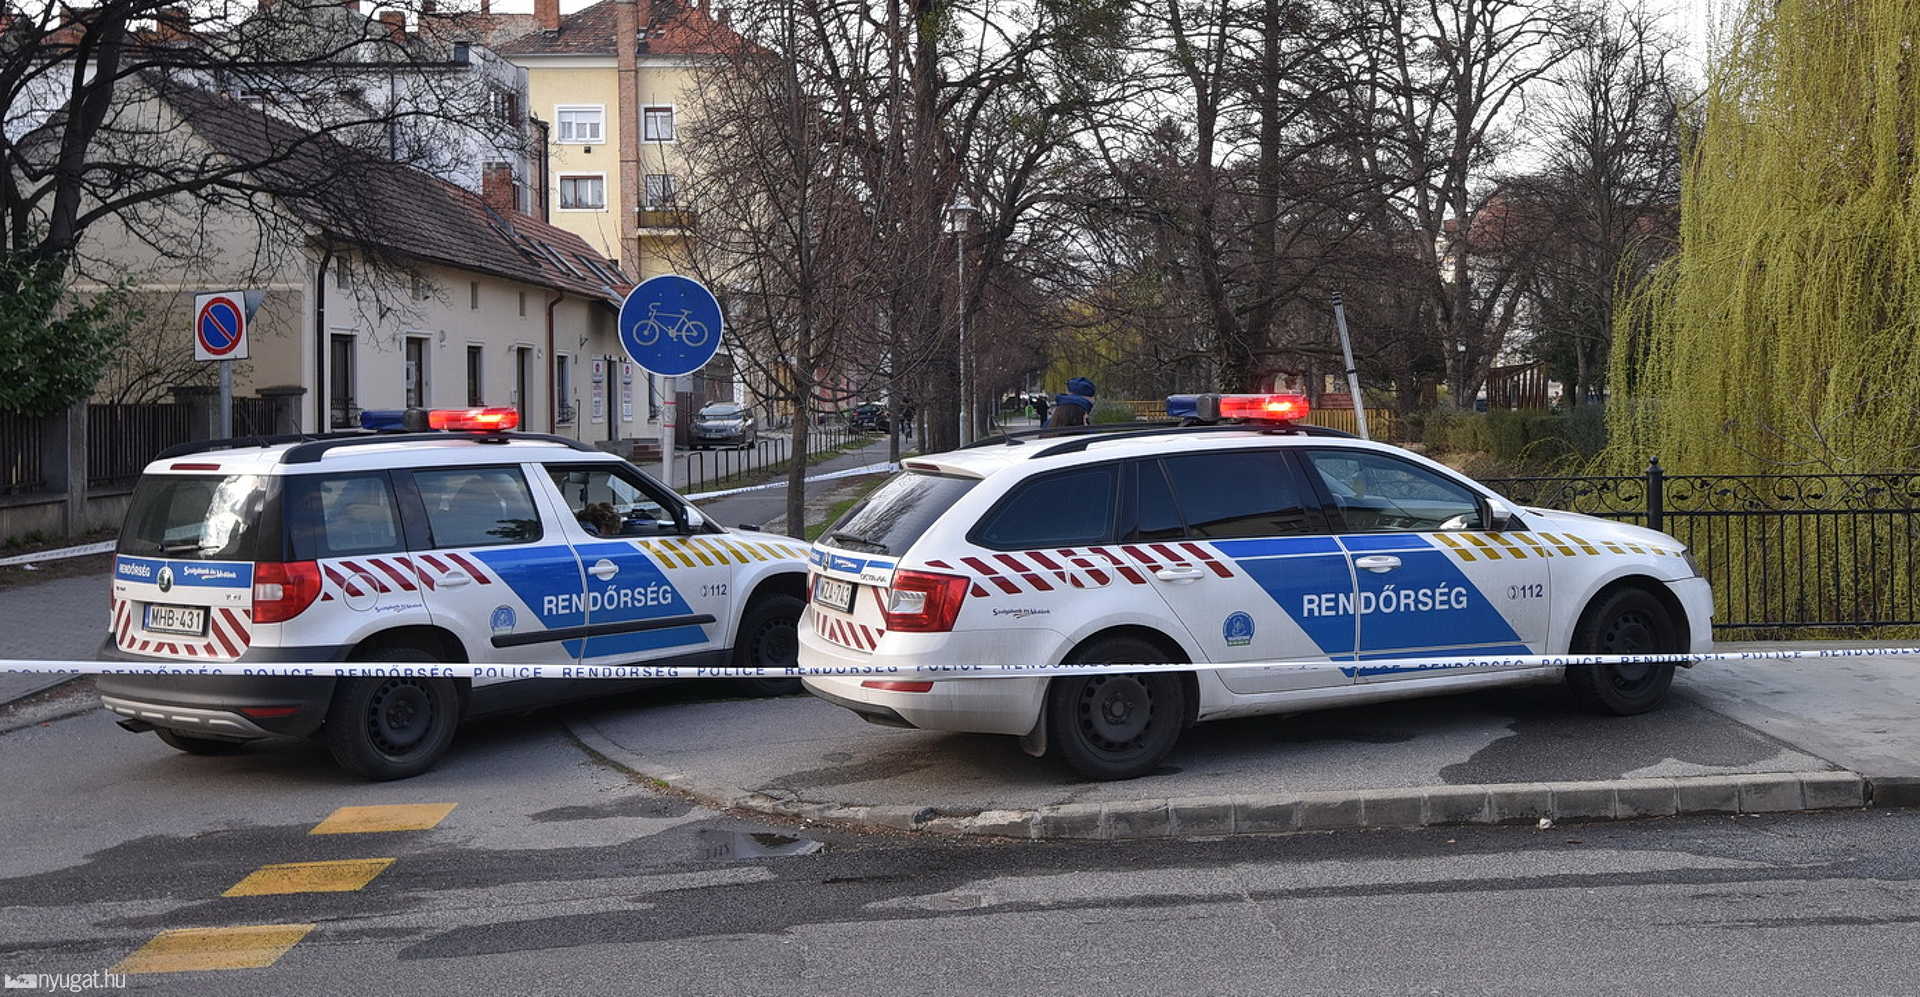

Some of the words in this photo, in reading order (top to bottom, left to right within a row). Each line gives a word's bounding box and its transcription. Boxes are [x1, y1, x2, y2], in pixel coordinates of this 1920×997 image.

[543, 582, 672, 617] RENDŐRSÉG
[710, 584, 727, 596] 112
[1520, 584, 1543, 598] 112
[1302, 582, 1468, 618] RENDŐRSÉG
[151, 606, 201, 630] MHB-431
[473, 667, 544, 679] POLICE
[697, 667, 766, 677] POLICE
